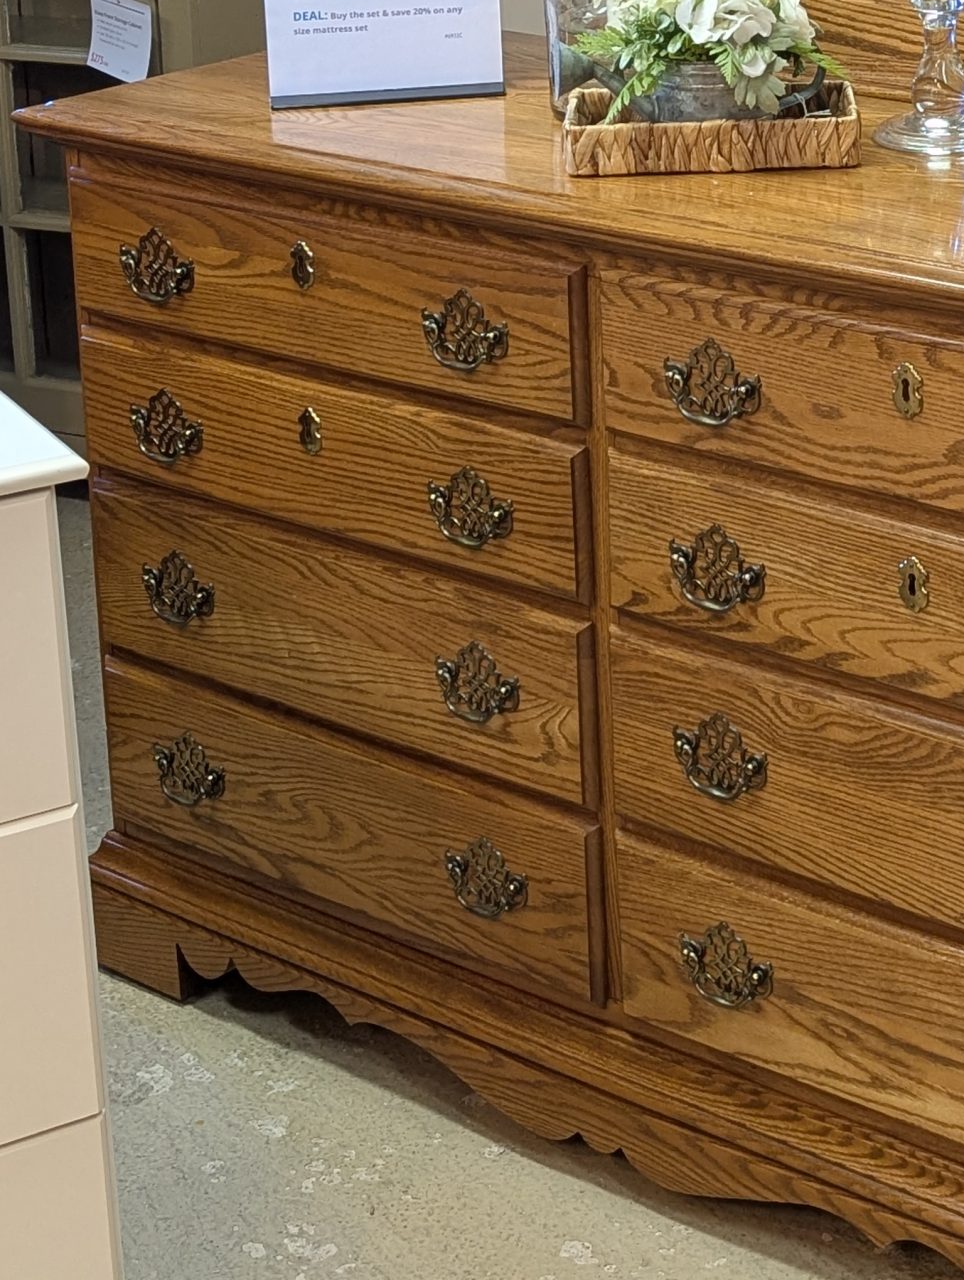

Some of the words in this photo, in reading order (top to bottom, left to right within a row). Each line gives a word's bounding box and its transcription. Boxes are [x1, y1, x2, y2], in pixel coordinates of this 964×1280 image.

[293, 10, 329, 22] DEAL:
[330, 12, 348, 21] Buy
[349, 10, 366, 19] the
[367, 10, 380, 18] set
[382, 9, 389, 17] &
[391, 9, 411, 17] save
[413, 7, 431, 16] 20%
[433, 7, 445, 15] on
[446, 6, 463, 15] any
[293, 26, 311, 35] size
[313, 25, 353, 35] mattress
[354, 24, 368, 32] set
